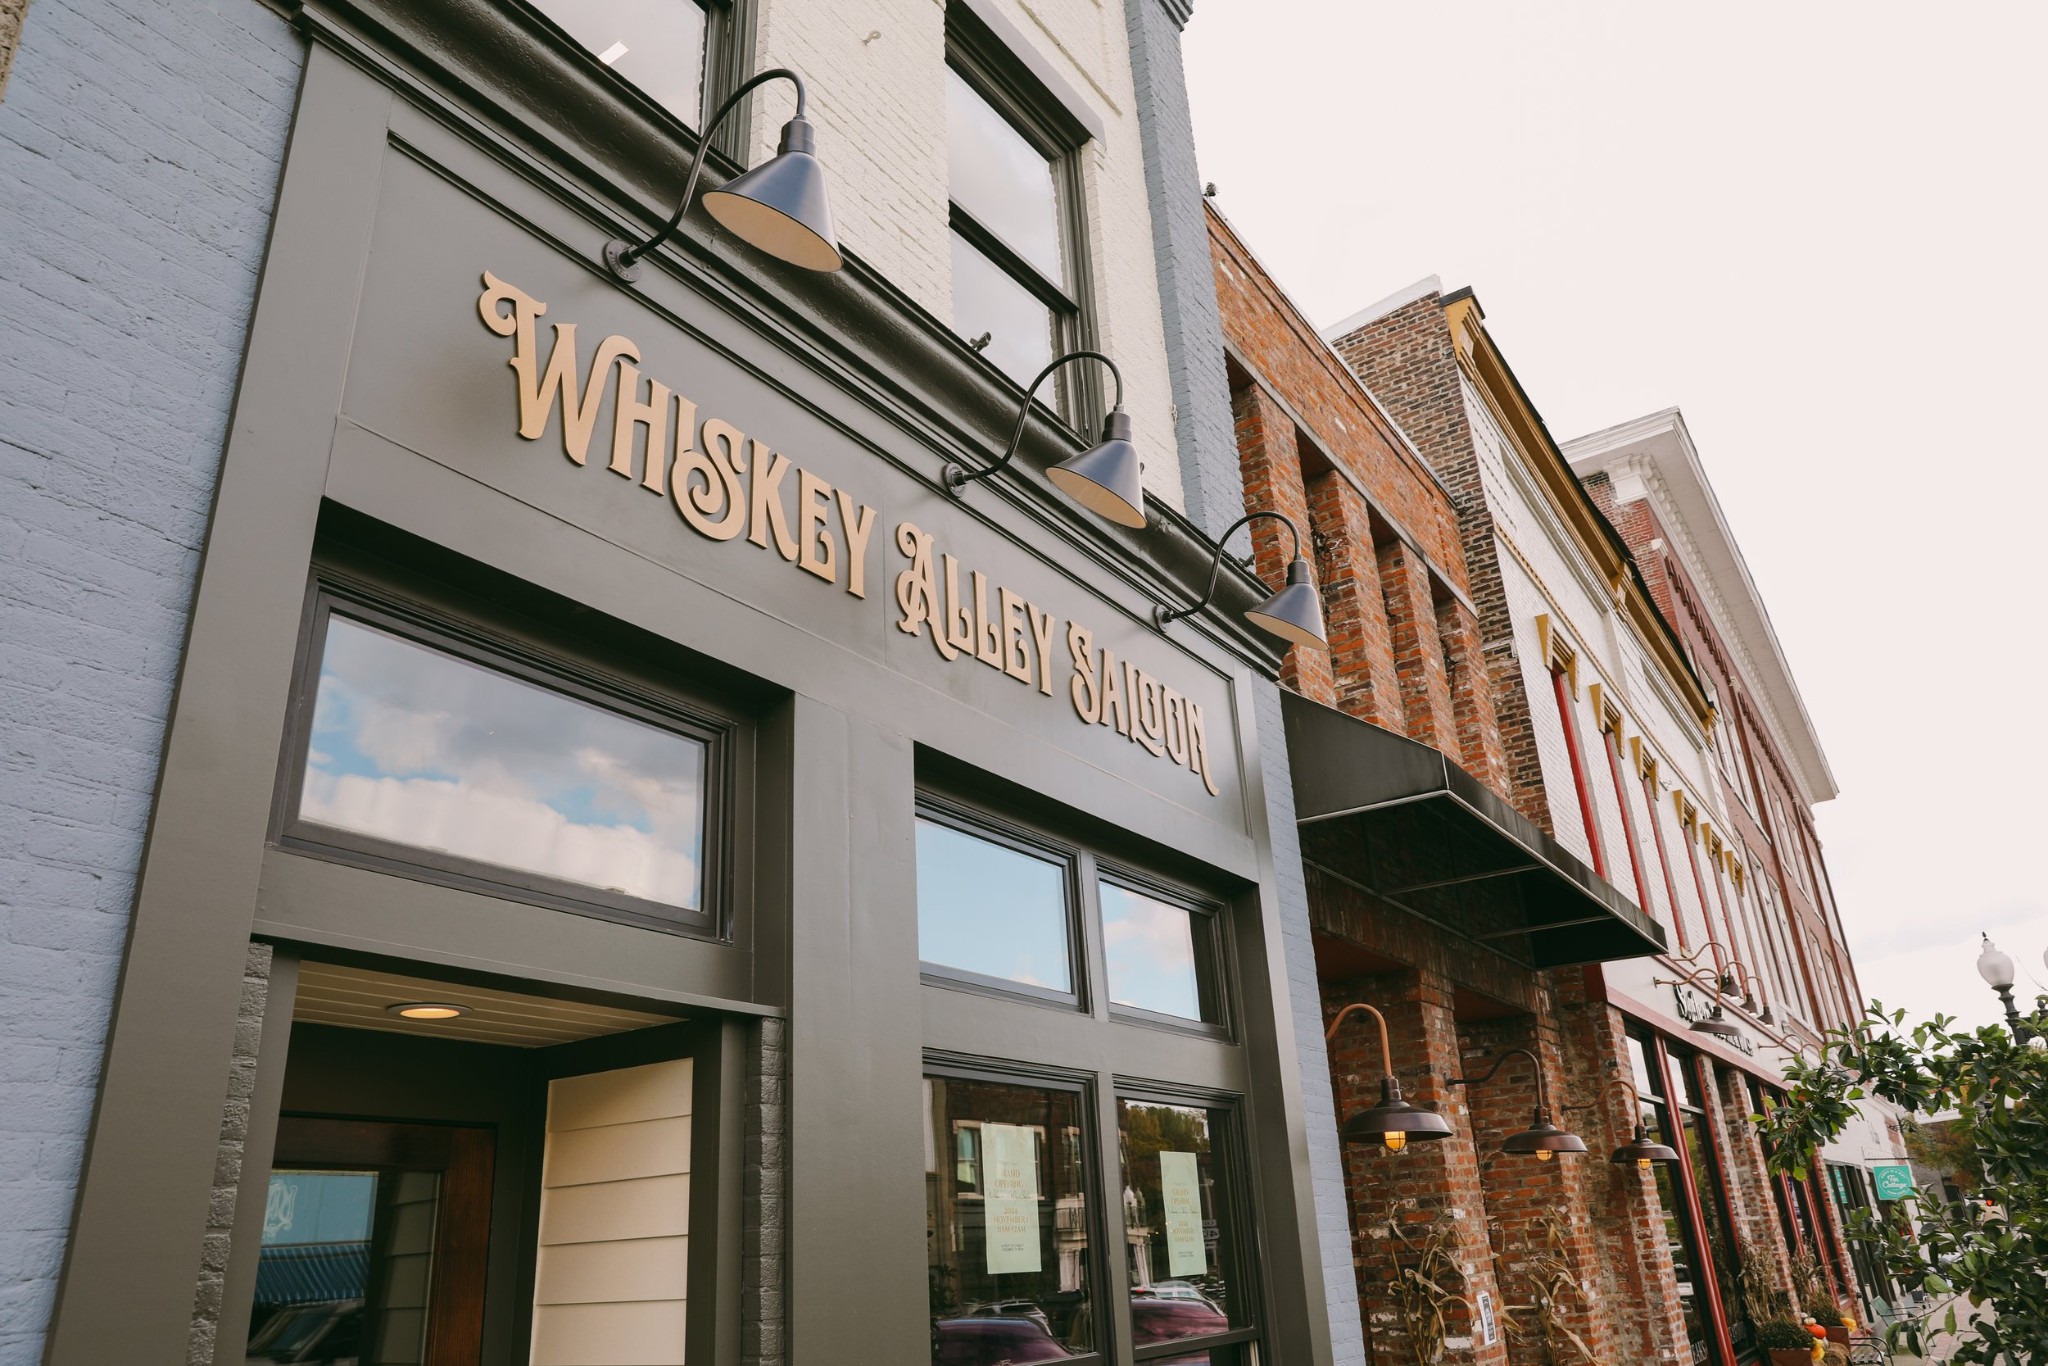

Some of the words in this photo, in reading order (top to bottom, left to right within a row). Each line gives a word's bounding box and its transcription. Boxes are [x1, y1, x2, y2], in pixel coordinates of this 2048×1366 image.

[478, 270, 878, 600] WHISKEY
[895, 522, 1057, 697] ALLEY
[1068, 620, 1220, 797] SALOON
